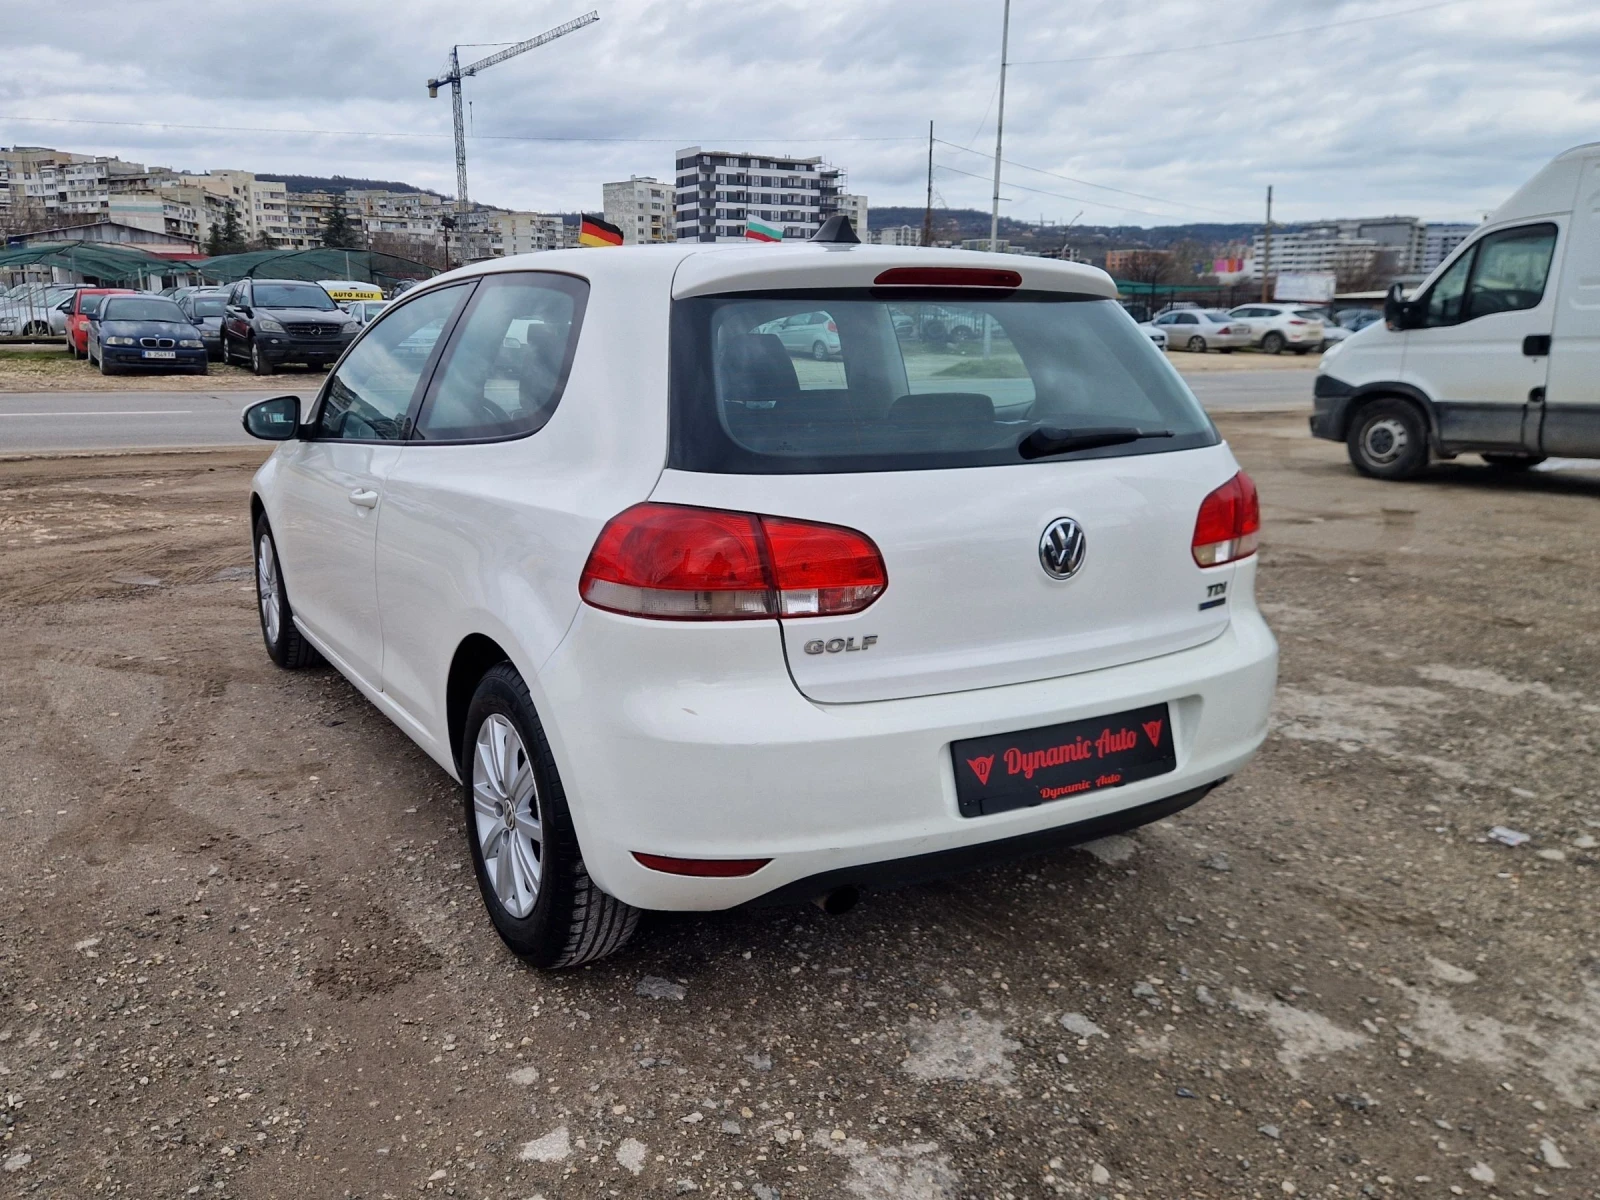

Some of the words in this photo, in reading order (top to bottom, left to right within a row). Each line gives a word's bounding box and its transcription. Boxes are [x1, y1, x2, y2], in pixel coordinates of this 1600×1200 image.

[1042, 519, 1084, 576] VW
[1207, 581, 1227, 597] TDI
[803, 634, 878, 655] GOLF
[1003, 736, 1092, 779] Dynamic
[1095, 728, 1138, 759] Auto
[1040, 780, 1091, 800] Dynamic
[1096, 773, 1122, 787] Auto
